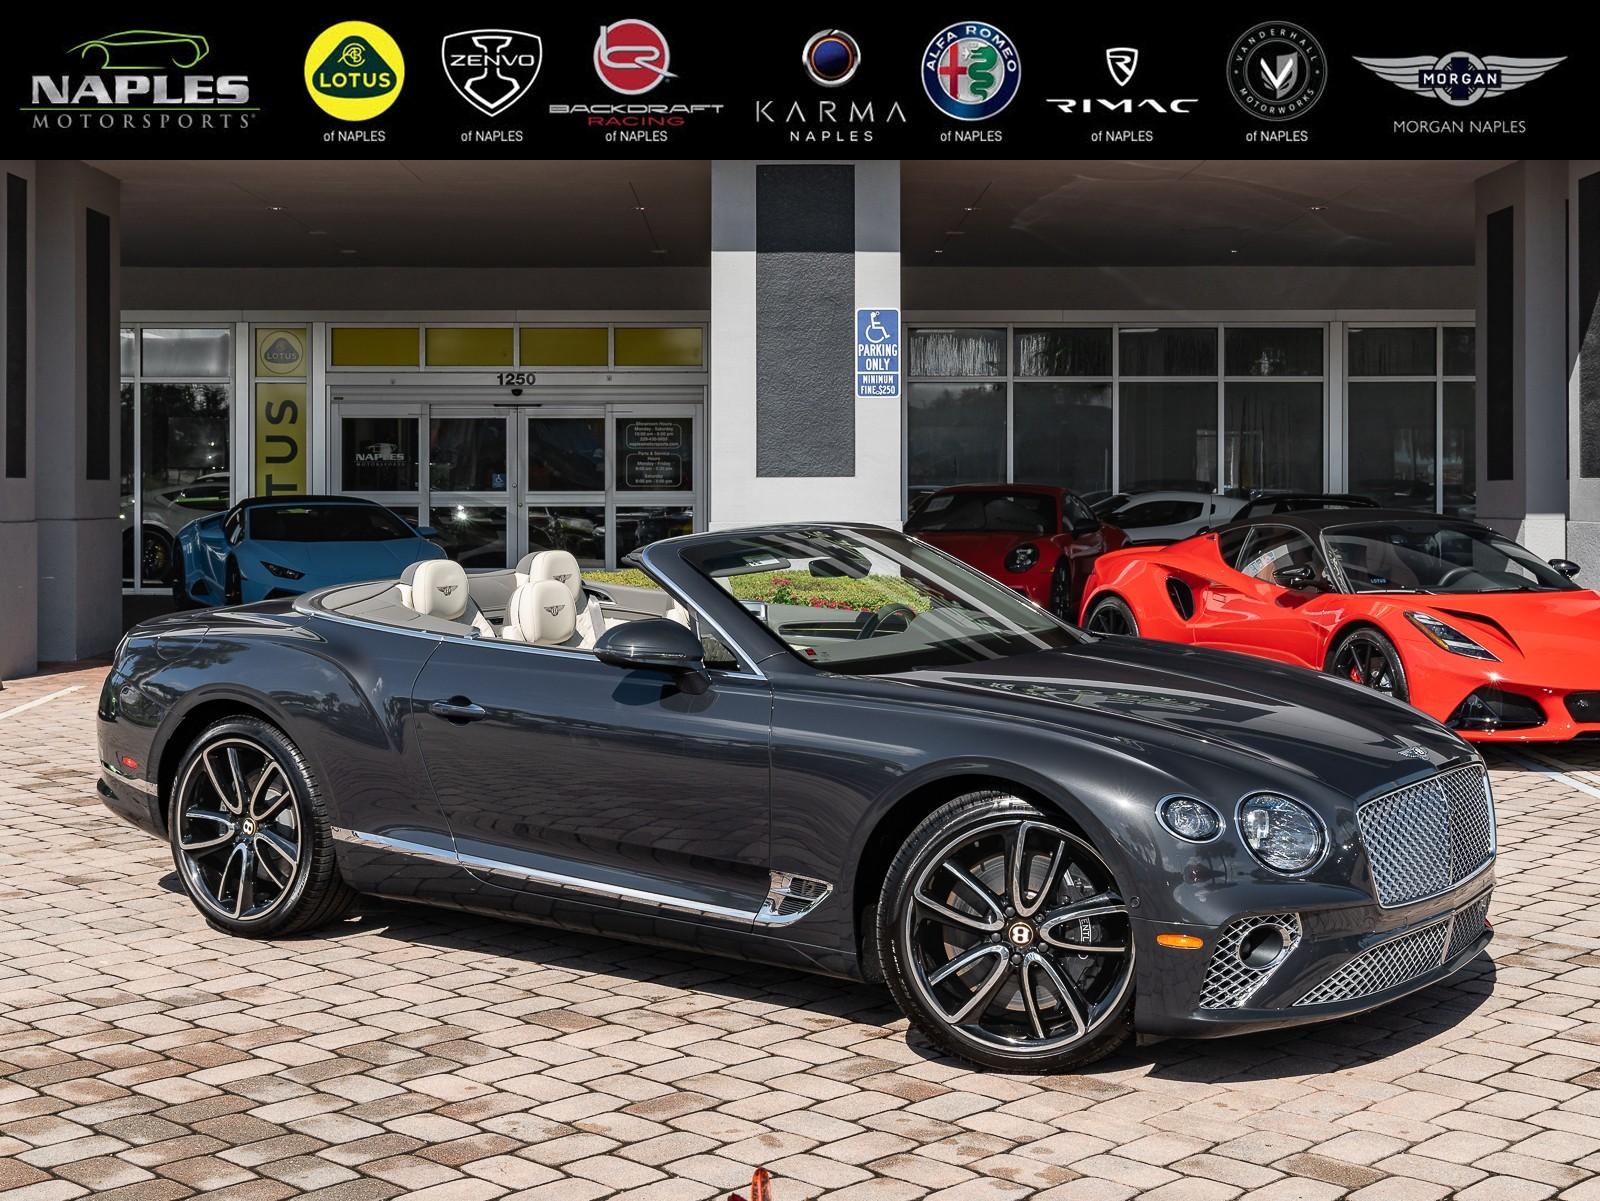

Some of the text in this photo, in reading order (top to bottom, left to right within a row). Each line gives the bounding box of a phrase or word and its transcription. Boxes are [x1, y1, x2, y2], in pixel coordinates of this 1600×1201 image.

[859, 344, 897, 356] PARKING
[267, 352, 297, 360] LOTUS
[866, 359, 890, 370] ONLY
[497, 373, 536, 386] 1250
[863, 375, 893, 384] MINIMUM
[861, 386, 895, 395] FINE $250
[265, 400, 298, 496] TUS
